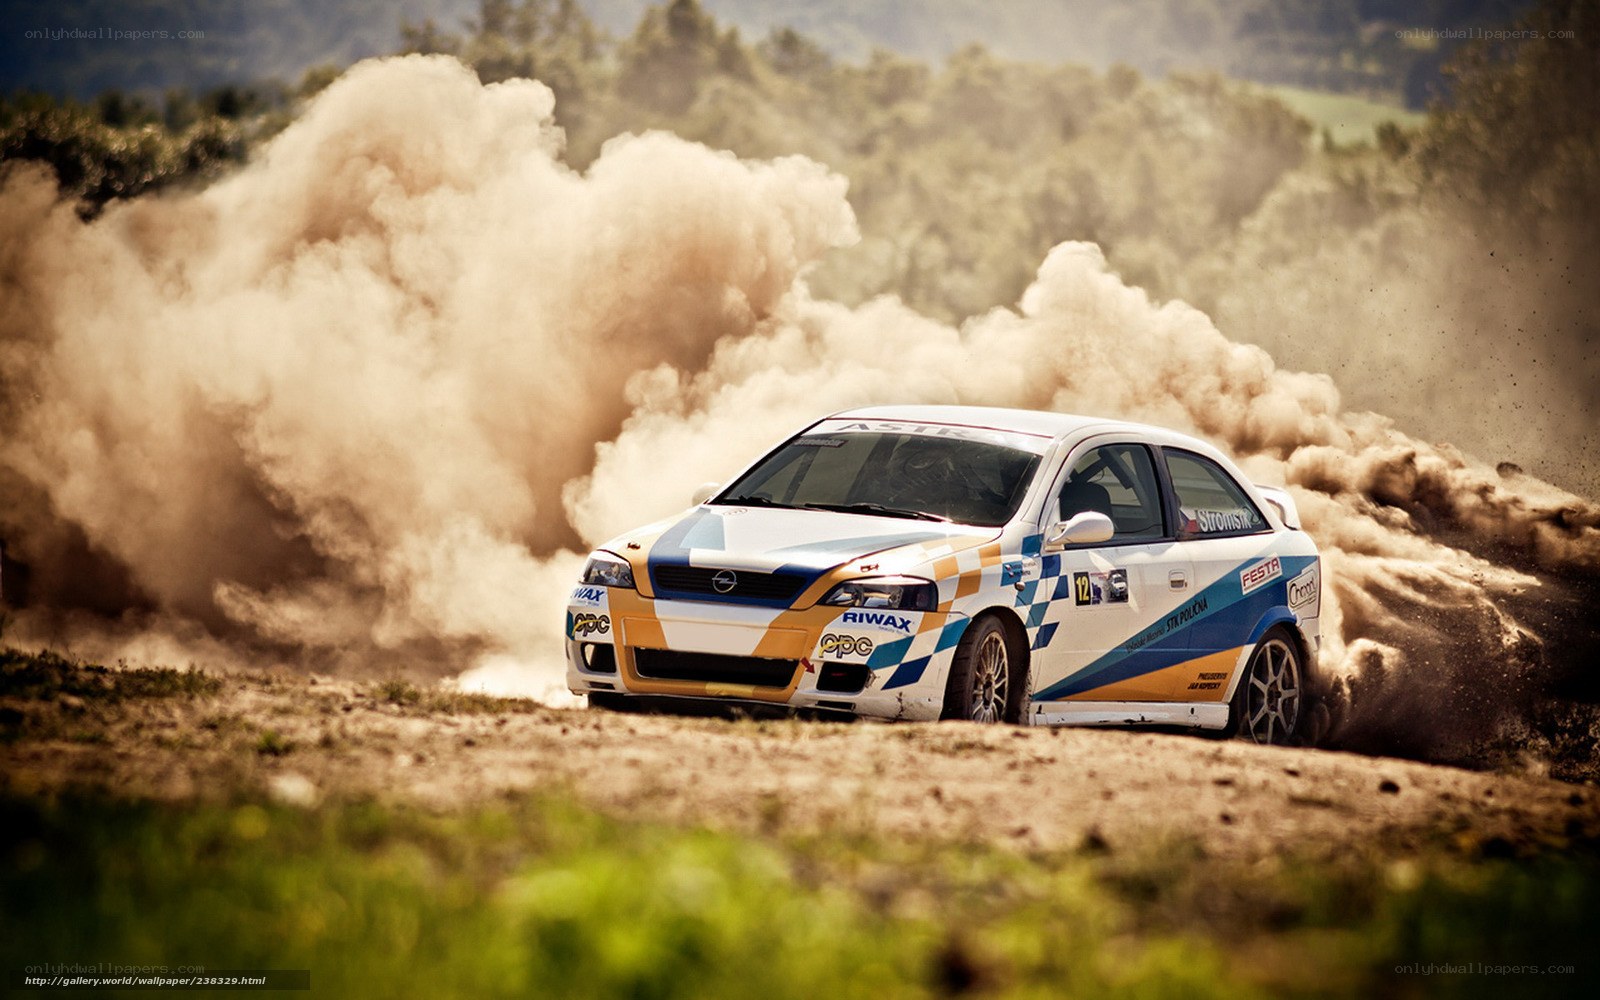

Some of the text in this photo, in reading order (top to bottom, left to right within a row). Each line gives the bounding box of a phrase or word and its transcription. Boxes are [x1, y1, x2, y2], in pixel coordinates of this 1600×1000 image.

[837, 422, 972, 438] ASTR
[1242, 557, 1280, 587] FESTA
[1076, 575, 1090, 602] 12
[842, 611, 912, 633] RIWAX
